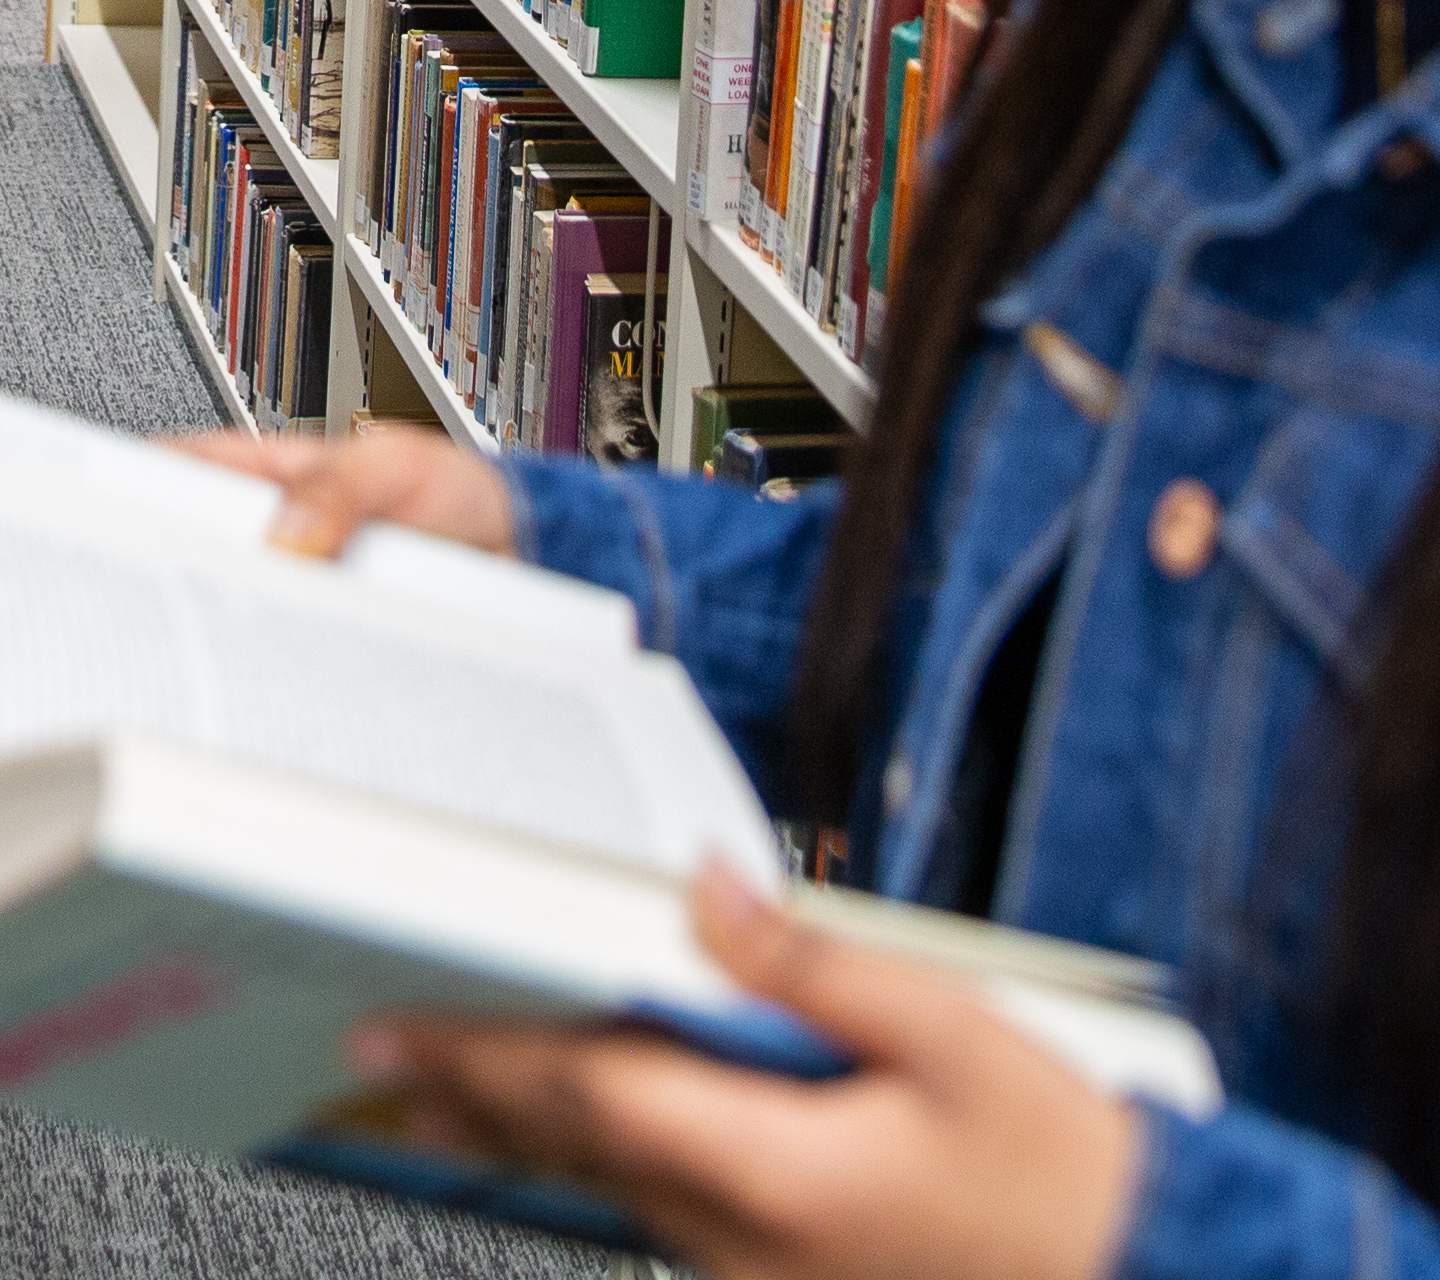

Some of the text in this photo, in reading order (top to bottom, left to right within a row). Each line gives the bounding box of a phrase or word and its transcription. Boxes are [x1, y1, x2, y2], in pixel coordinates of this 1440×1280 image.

[695, 55, 709, 71] ONE
[692, 69, 711, 84] WEEK
[728, 77, 751, 86] WEE
[691, 82, 710, 98] LOAN
[728, 90, 750, 100] LOA
[448, 147, 458, 239] FAULKNER'S
